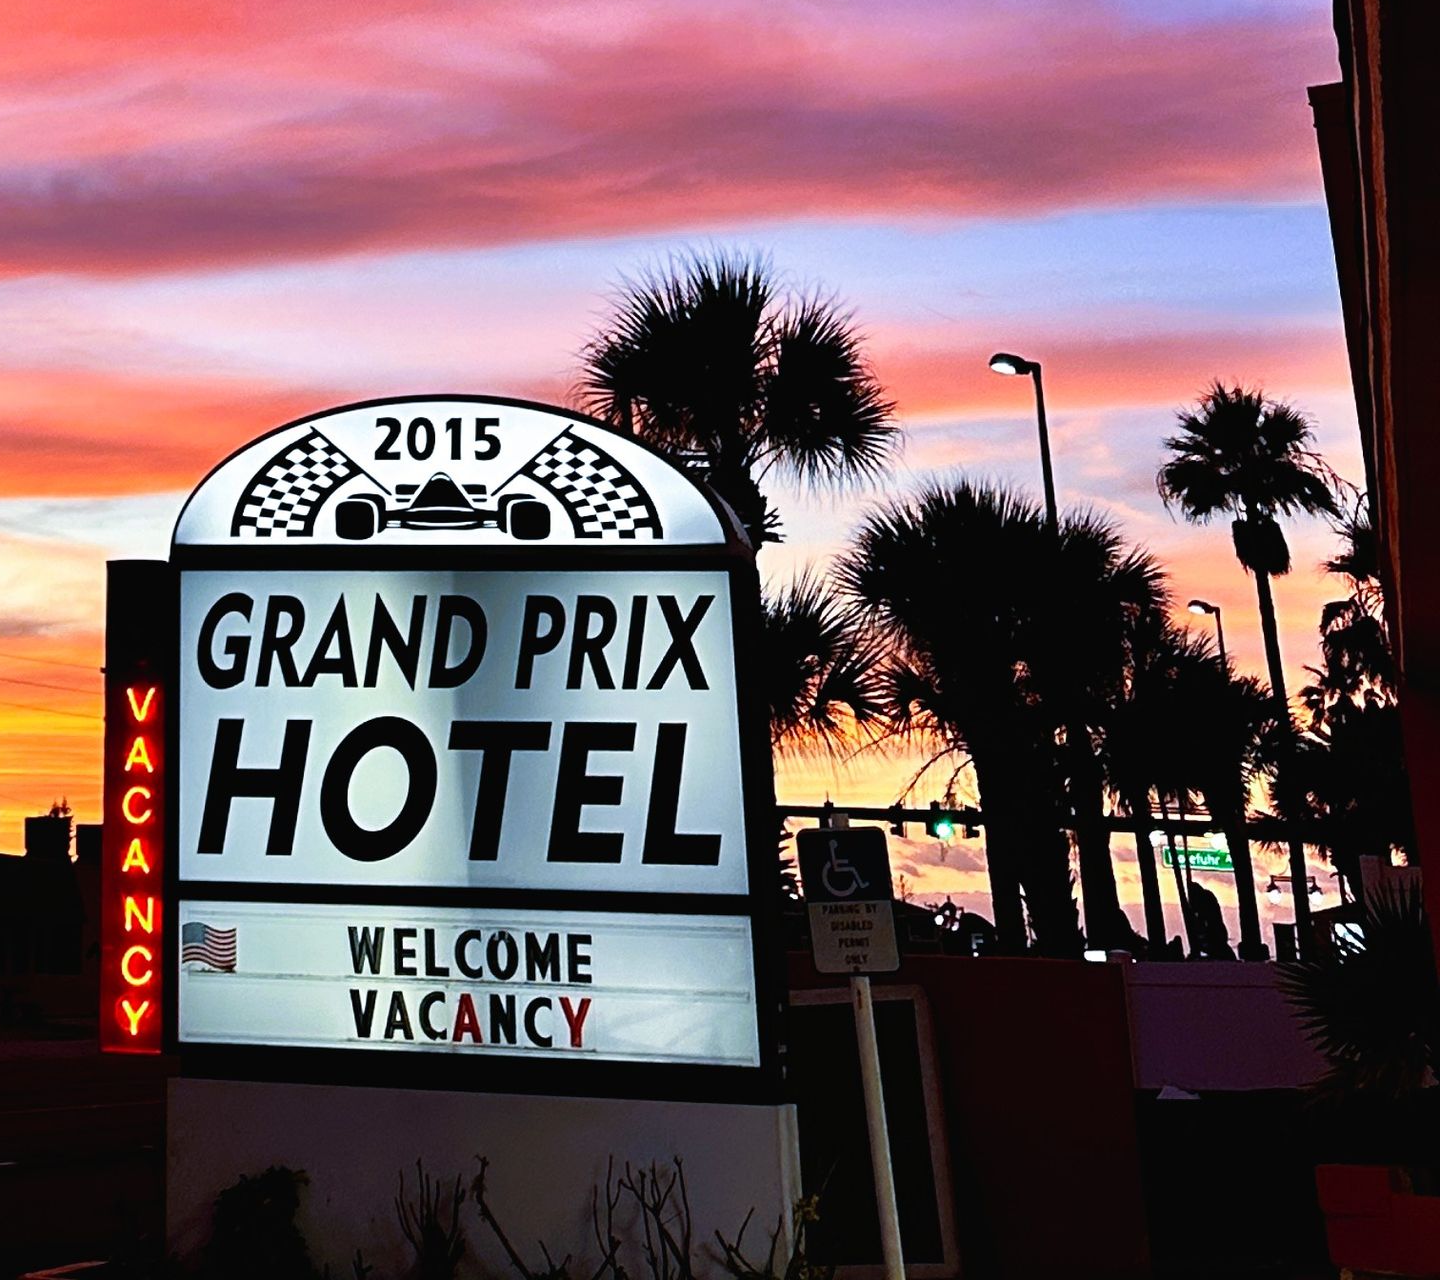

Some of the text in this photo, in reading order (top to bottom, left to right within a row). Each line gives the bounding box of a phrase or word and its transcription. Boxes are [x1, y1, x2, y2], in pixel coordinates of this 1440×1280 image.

[374, 416, 501, 461] 2015
[197, 592, 716, 691] GRAND PRIX
[197, 715, 722, 866] HOTEL
[121, 687, 157, 1036] VACANCY
[1168, 852, 1220, 866] oefuhr
[348, 926, 592, 984] WELCOME
[349, 989, 592, 1048] VACANCY
